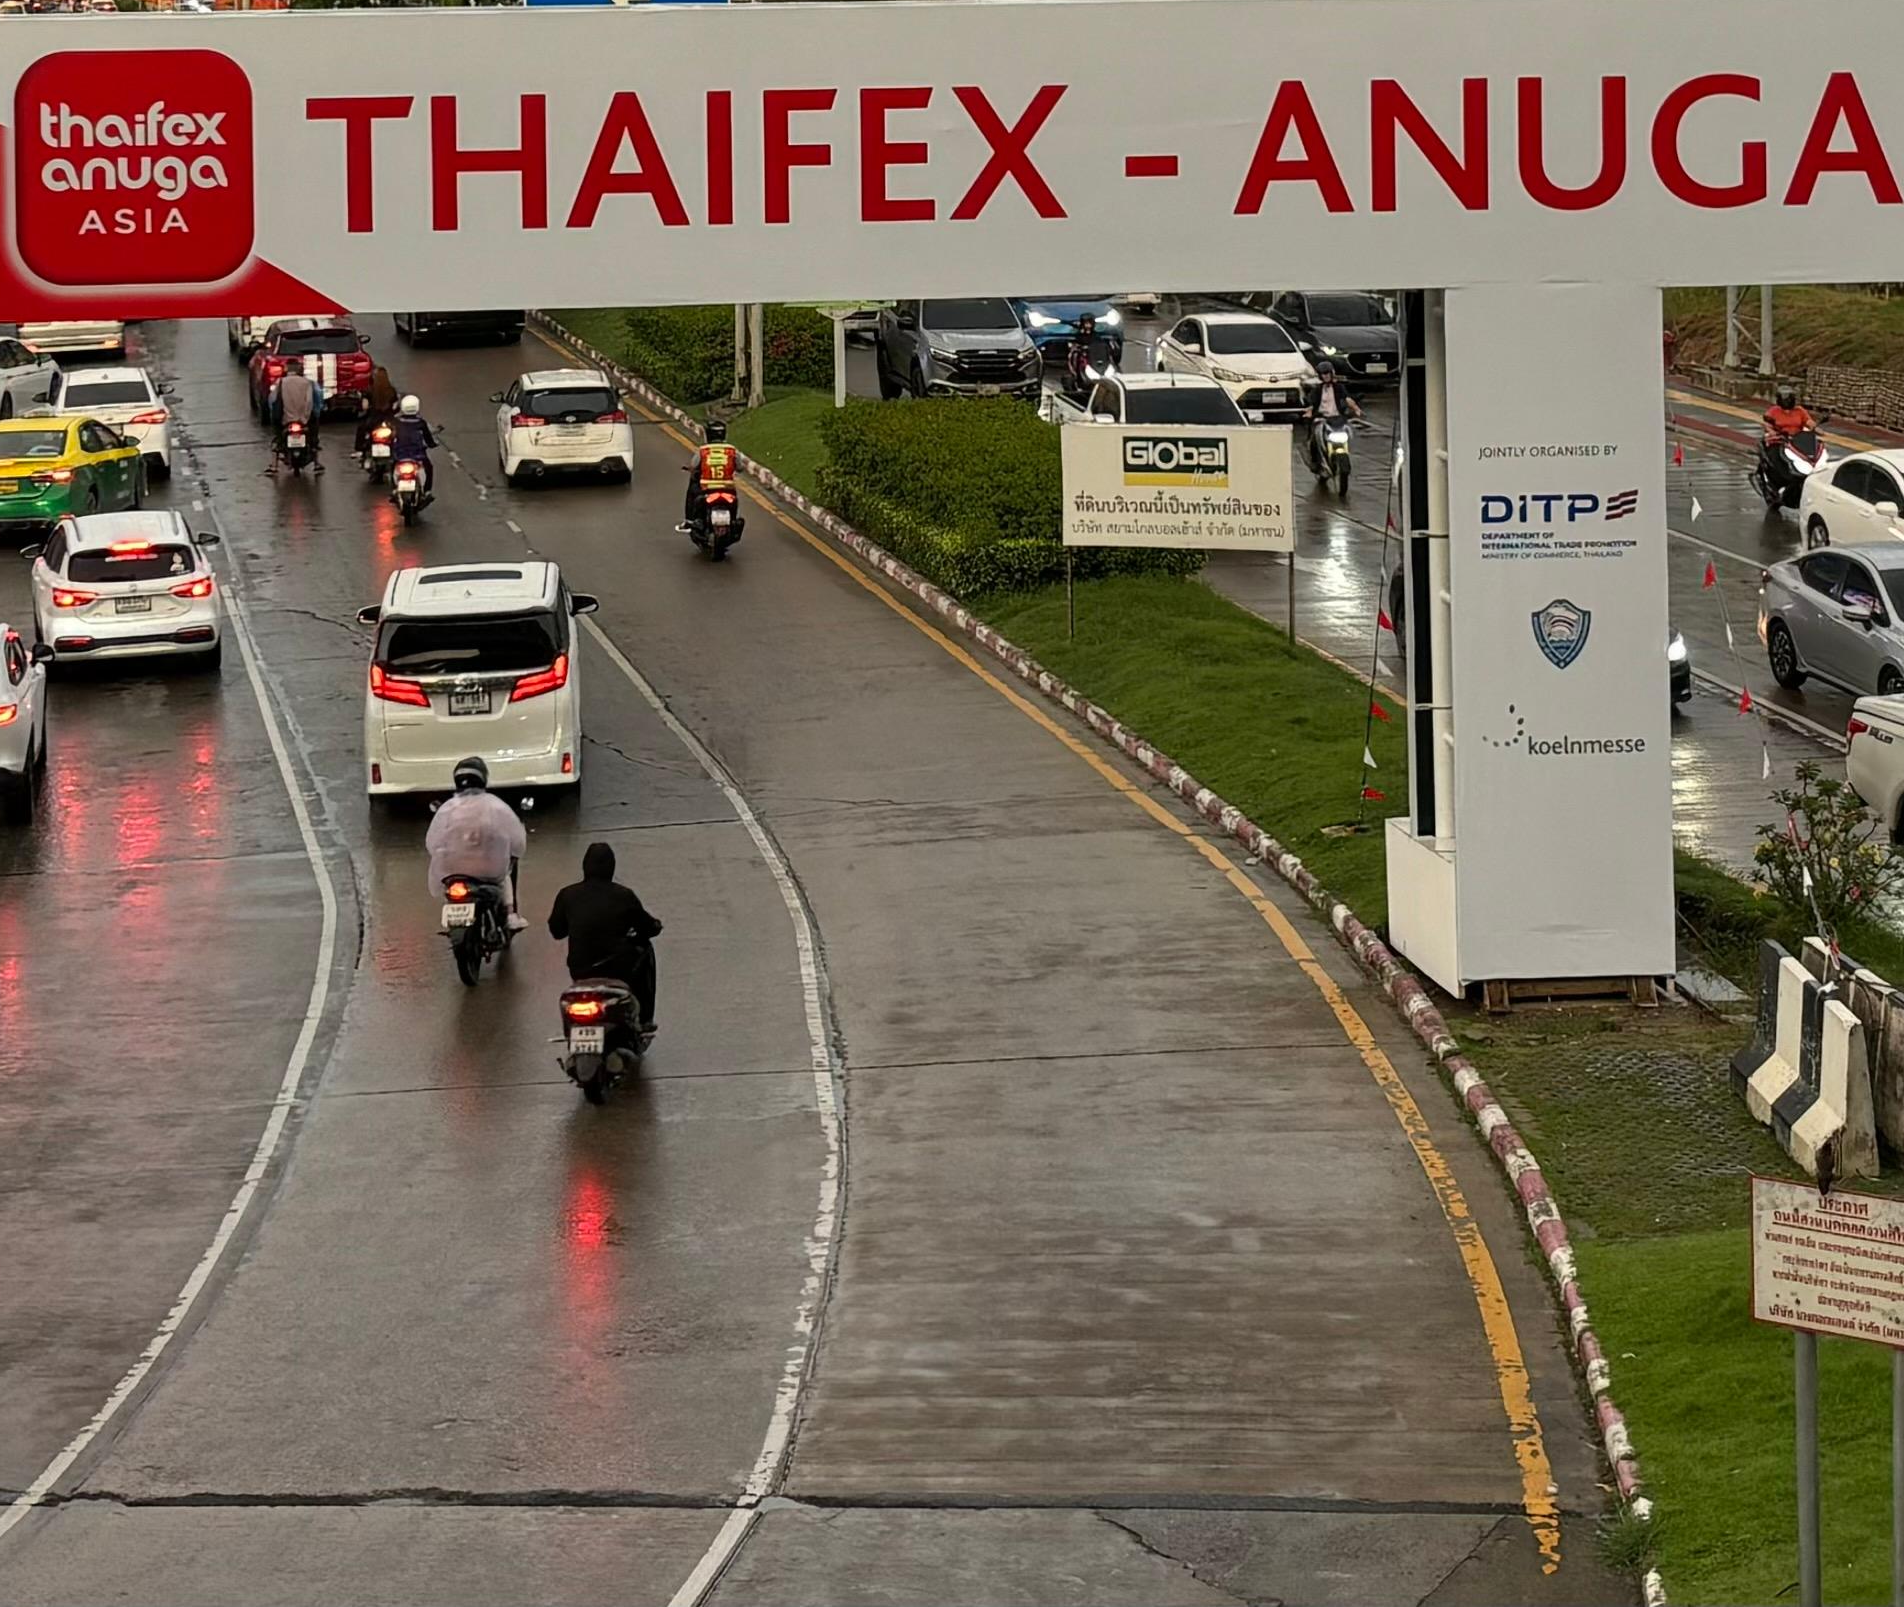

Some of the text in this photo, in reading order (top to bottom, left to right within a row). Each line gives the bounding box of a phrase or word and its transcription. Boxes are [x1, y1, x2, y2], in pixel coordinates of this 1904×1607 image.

[40, 100, 227, 147] thaifex
[305, 84, 1068, 234] THAIFEX
[1124, 155, 1179, 177] -
[1233, 71, 1904, 216] ANUGA
[41, 155, 228, 201] anuga
[78, 207, 189, 235] ASIA
[1125, 440, 1226, 471] Global
[1478, 444, 1618, 461] JOINTLY ORGANISED BY
[710, 465, 725, 479] 15
[1072, 519, 1103, 534] บริษัท
[1481, 532, 1555, 540] DEPARTMENT OF
[1481, 540, 1638, 550] INTERNATIONAL TRADE PROMOTION
[1481, 552, 1519, 560] MINISTRY
[1528, 734, 1647, 756] koelnmesse
[1818, 1196, 1869, 1217] ประกาศ
